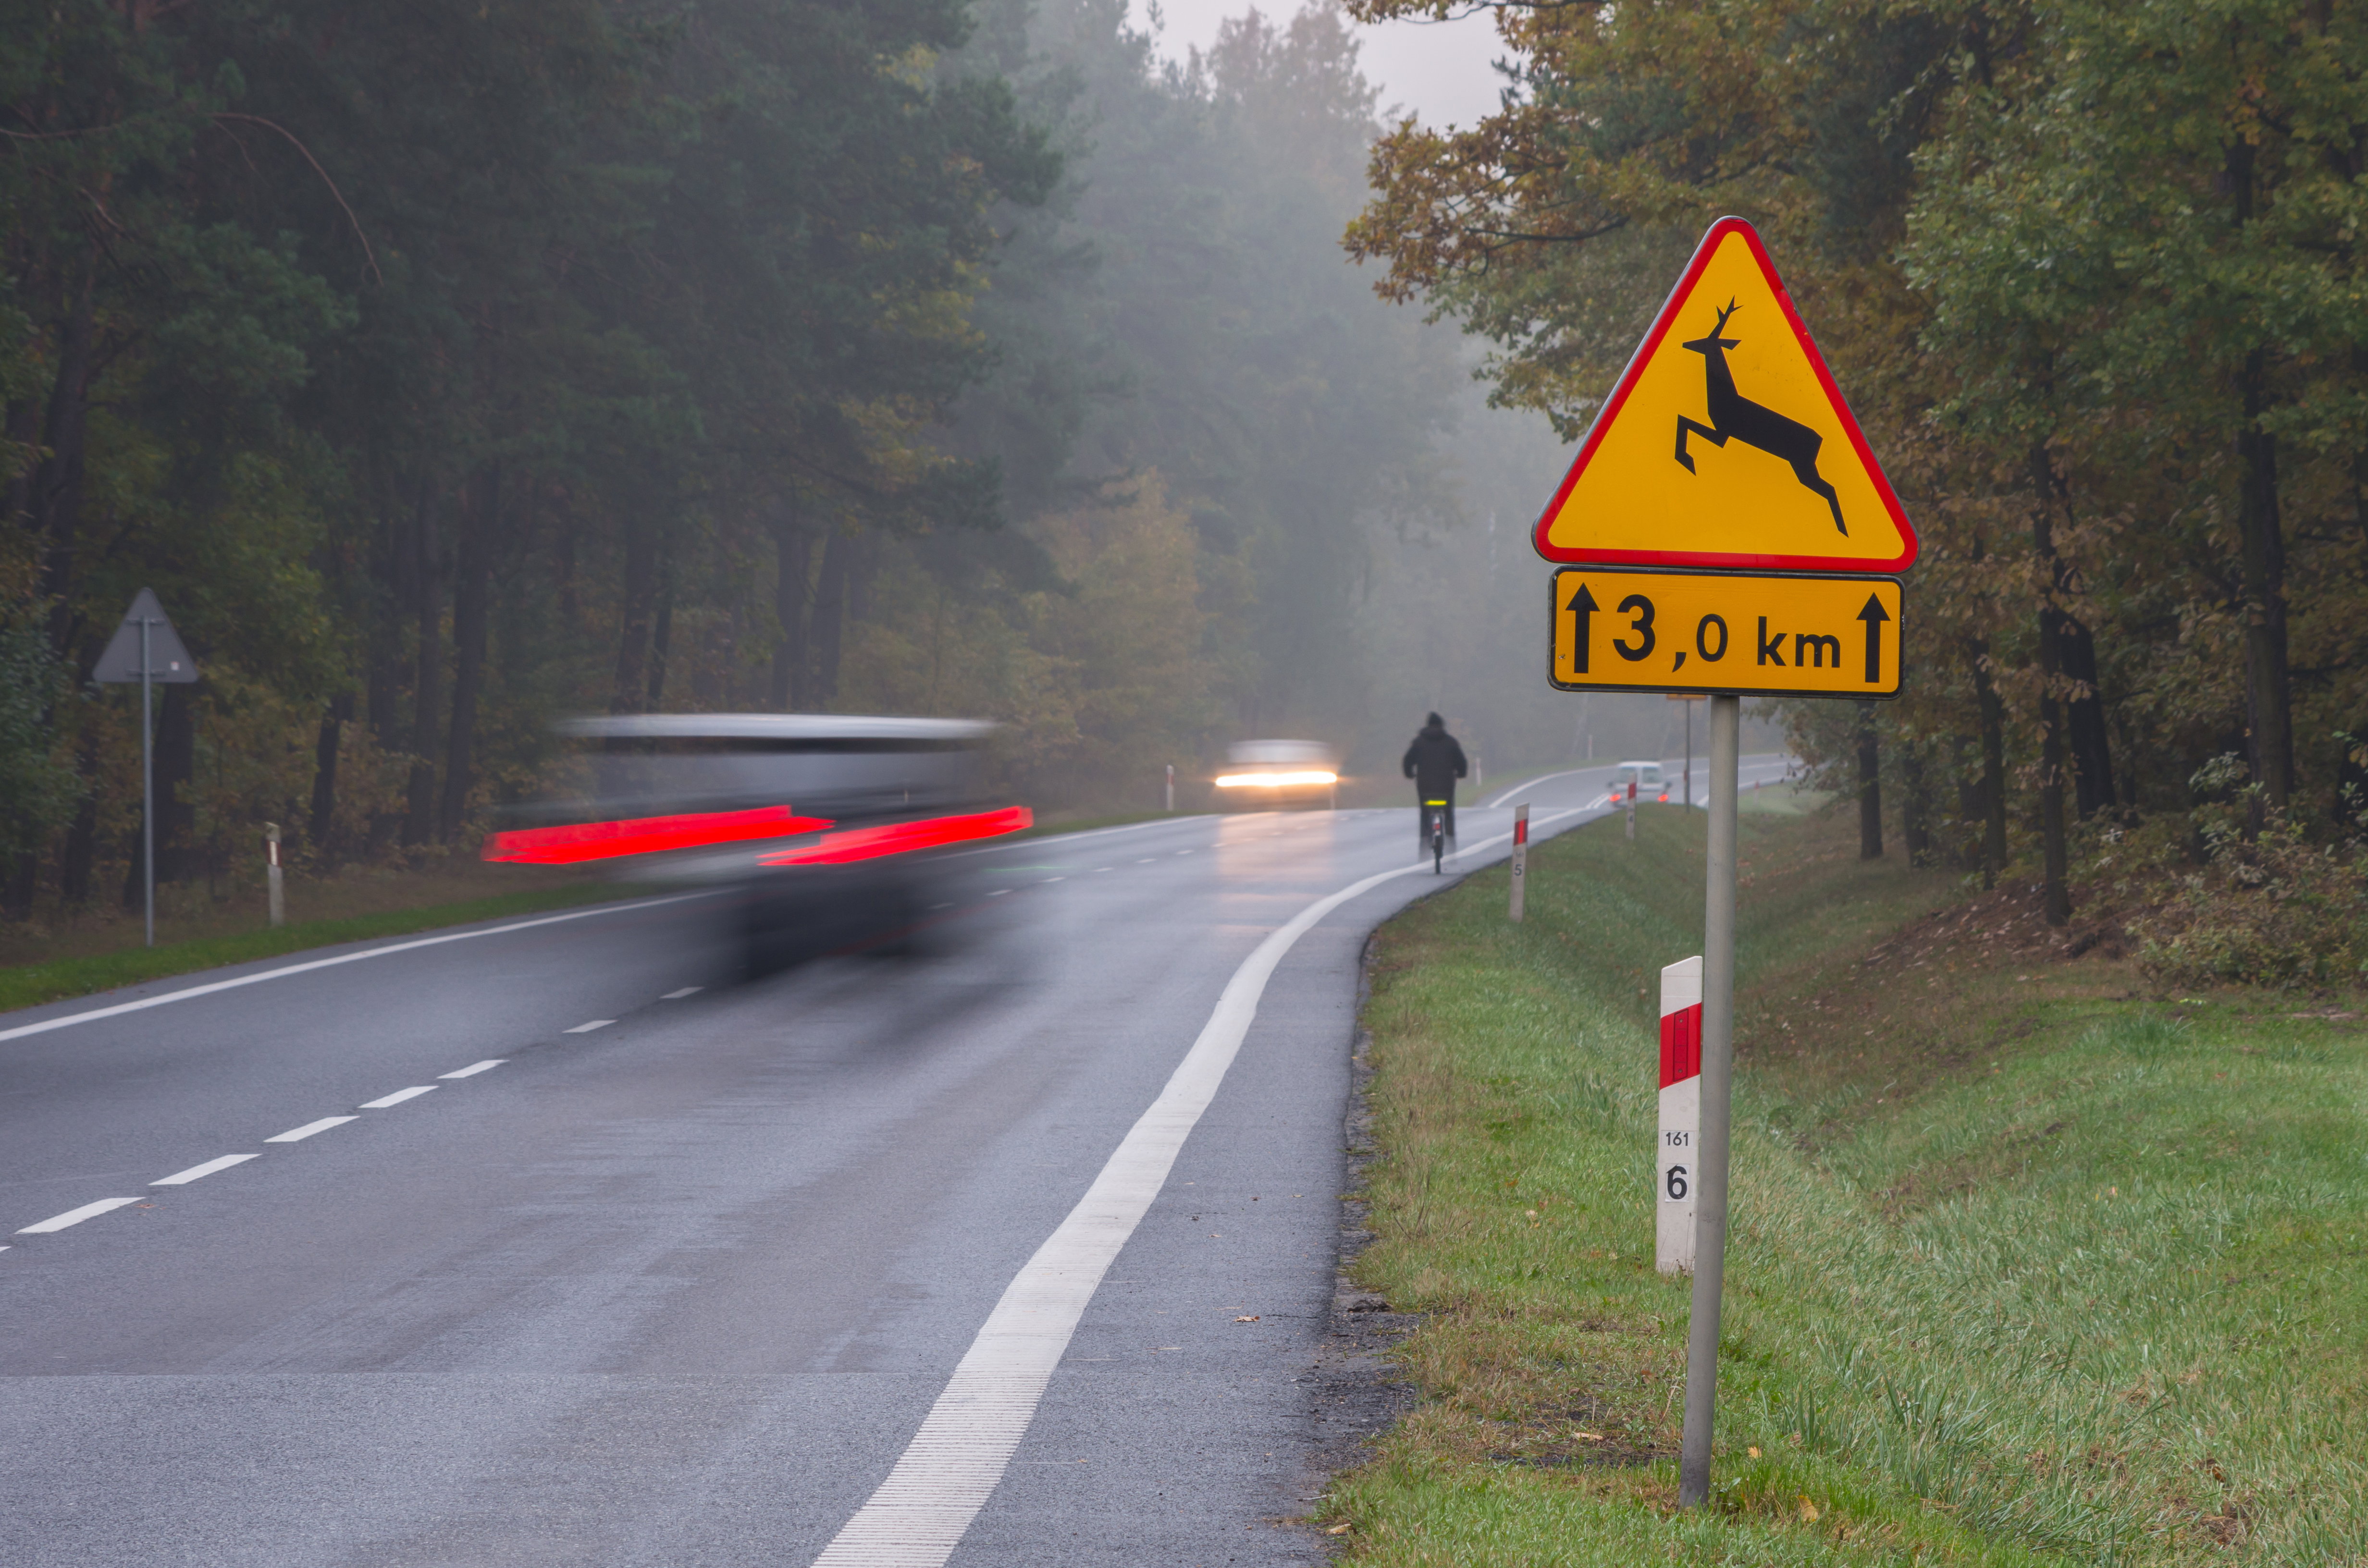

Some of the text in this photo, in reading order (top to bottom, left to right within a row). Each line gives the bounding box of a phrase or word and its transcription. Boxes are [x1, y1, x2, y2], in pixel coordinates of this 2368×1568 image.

[1757, 616, 1840, 668] km
[1515, 864, 1522, 876] 5
[1666, 1131, 1689, 1147] 161
[1666, 1165, 1688, 1200] 6
